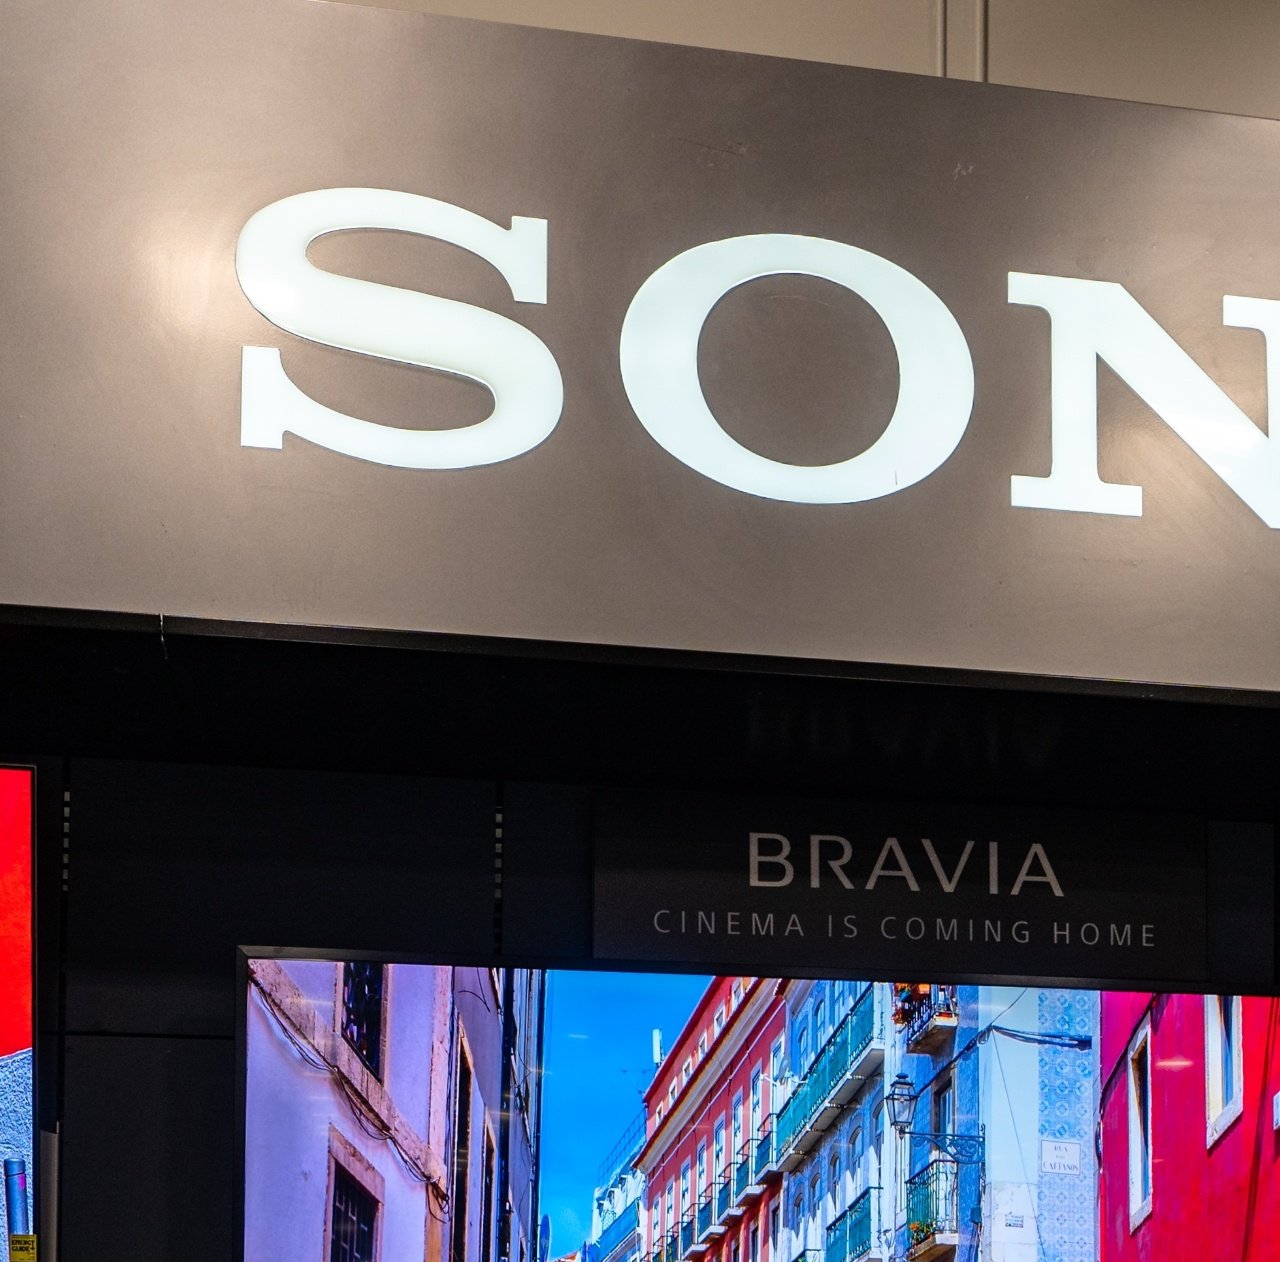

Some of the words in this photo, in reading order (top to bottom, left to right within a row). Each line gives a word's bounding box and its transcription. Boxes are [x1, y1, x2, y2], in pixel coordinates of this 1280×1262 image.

[748, 832, 1064, 897] BRAVIA
[654, 909, 804, 937] CINEMA
[828, 914, 858, 939] IS
[880, 916, 1030, 944] COMING
[1053, 922, 1155, 947] HOME
